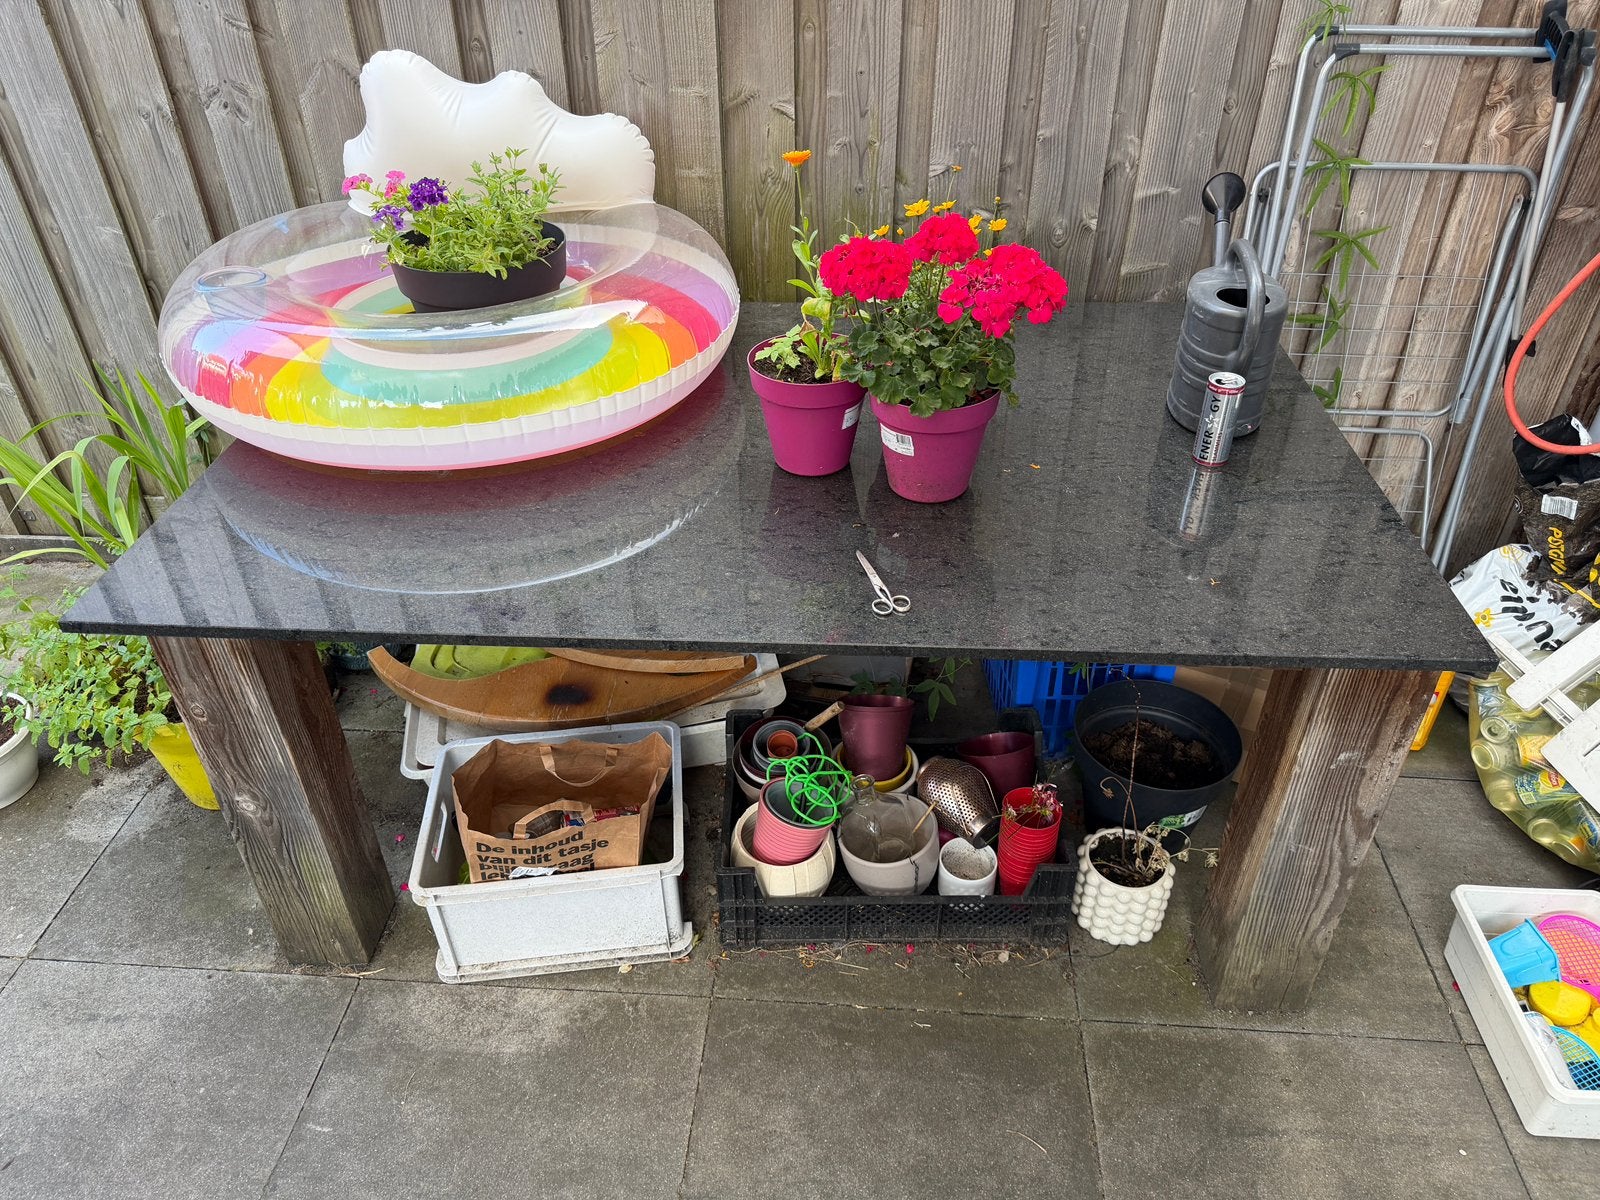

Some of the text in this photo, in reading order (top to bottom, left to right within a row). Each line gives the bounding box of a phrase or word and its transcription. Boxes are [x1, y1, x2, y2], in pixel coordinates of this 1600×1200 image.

[476, 831, 584, 854] De inhoud
[477, 838, 609, 865] van dit tasje
